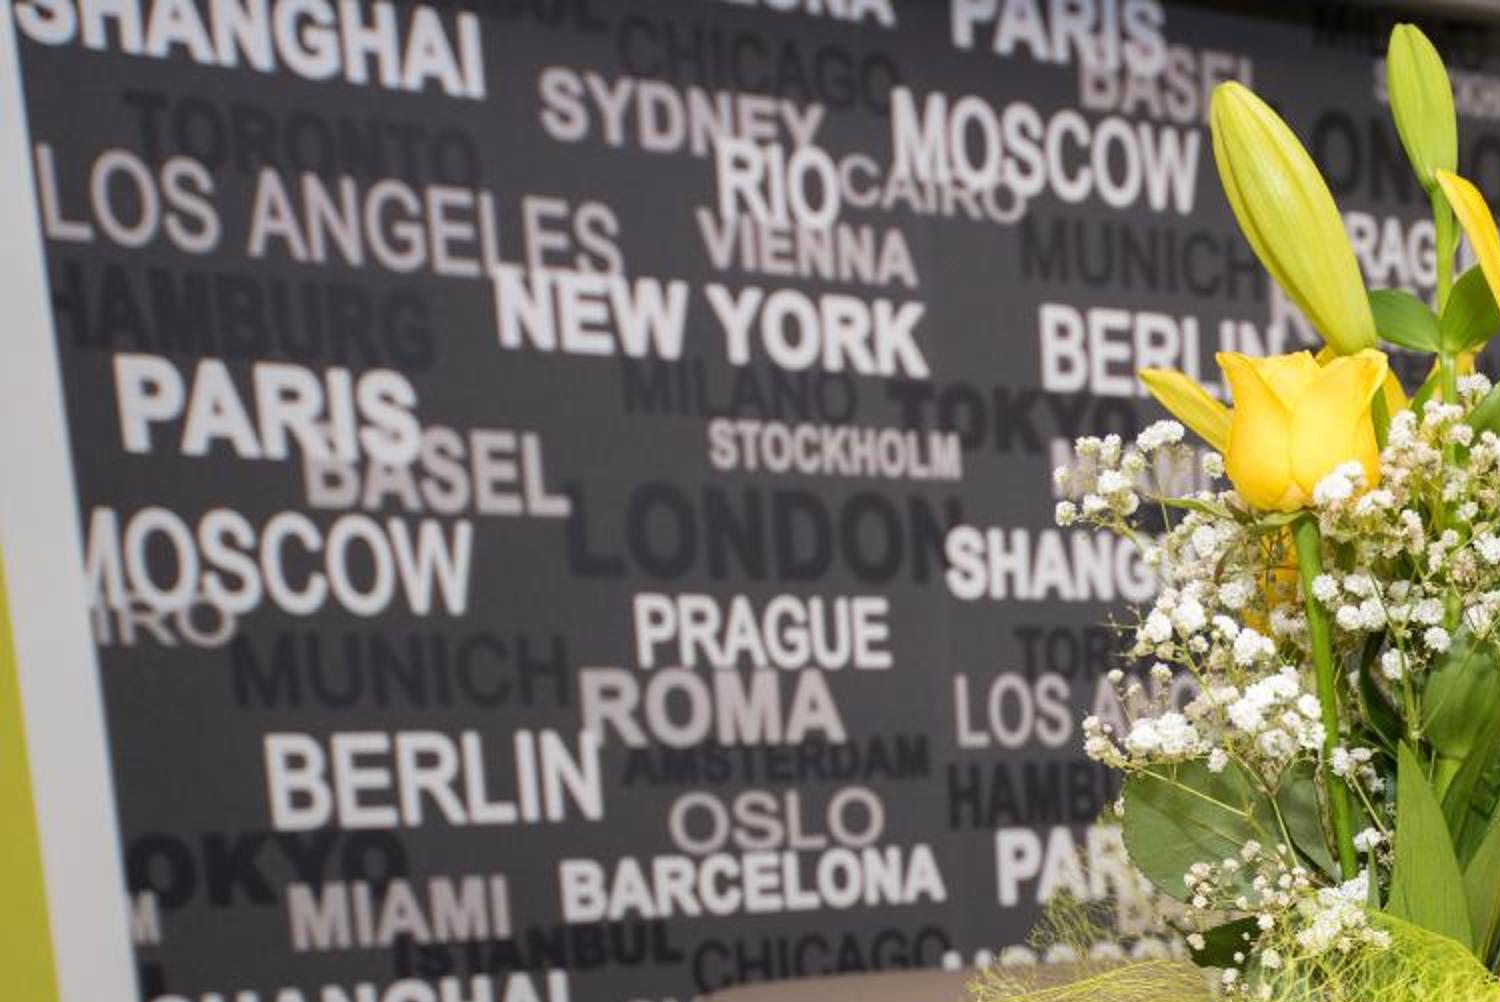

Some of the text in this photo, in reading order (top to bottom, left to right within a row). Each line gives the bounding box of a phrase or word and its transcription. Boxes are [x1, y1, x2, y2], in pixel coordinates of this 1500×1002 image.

[14, 0, 486, 98] SHANGHAI
[949, 0, 1166, 73] PARIS
[538, 66, 826, 158] SYDNEY
[1078, 43, 1255, 126] BASE
[122, 88, 483, 187] TORONTO
[890, 84, 1202, 216] MOSCOW
[33, 142, 628, 282] LOS ANGELES
[716, 134, 840, 229] RIO
[694, 205, 920, 289] VIENNA
[1020, 218, 1268, 302] MUNICH
[494, 262, 931, 380] NEW YORK
[112, 352, 420, 463] PARIS
[620, 352, 858, 426] MILANO
[302, 424, 573, 518] BASEL
[708, 418, 963, 482] STOCKHOLM
[562, 480, 966, 584] LONDON
[944, 524, 1180, 602] SHANG
[228, 632, 575, 710] MUNICH
[633, 592, 894, 670] PRAGUE
[577, 664, 847, 748] ROMA
[953, 672, 1073, 749] LOS
[262, 728, 606, 832] BERLIN
[622, 735, 930, 788] AMSTERDAM
[667, 786, 886, 856] OSLO
[286, 874, 513, 952] MIAMI
[557, 843, 947, 925] BARCELONA
